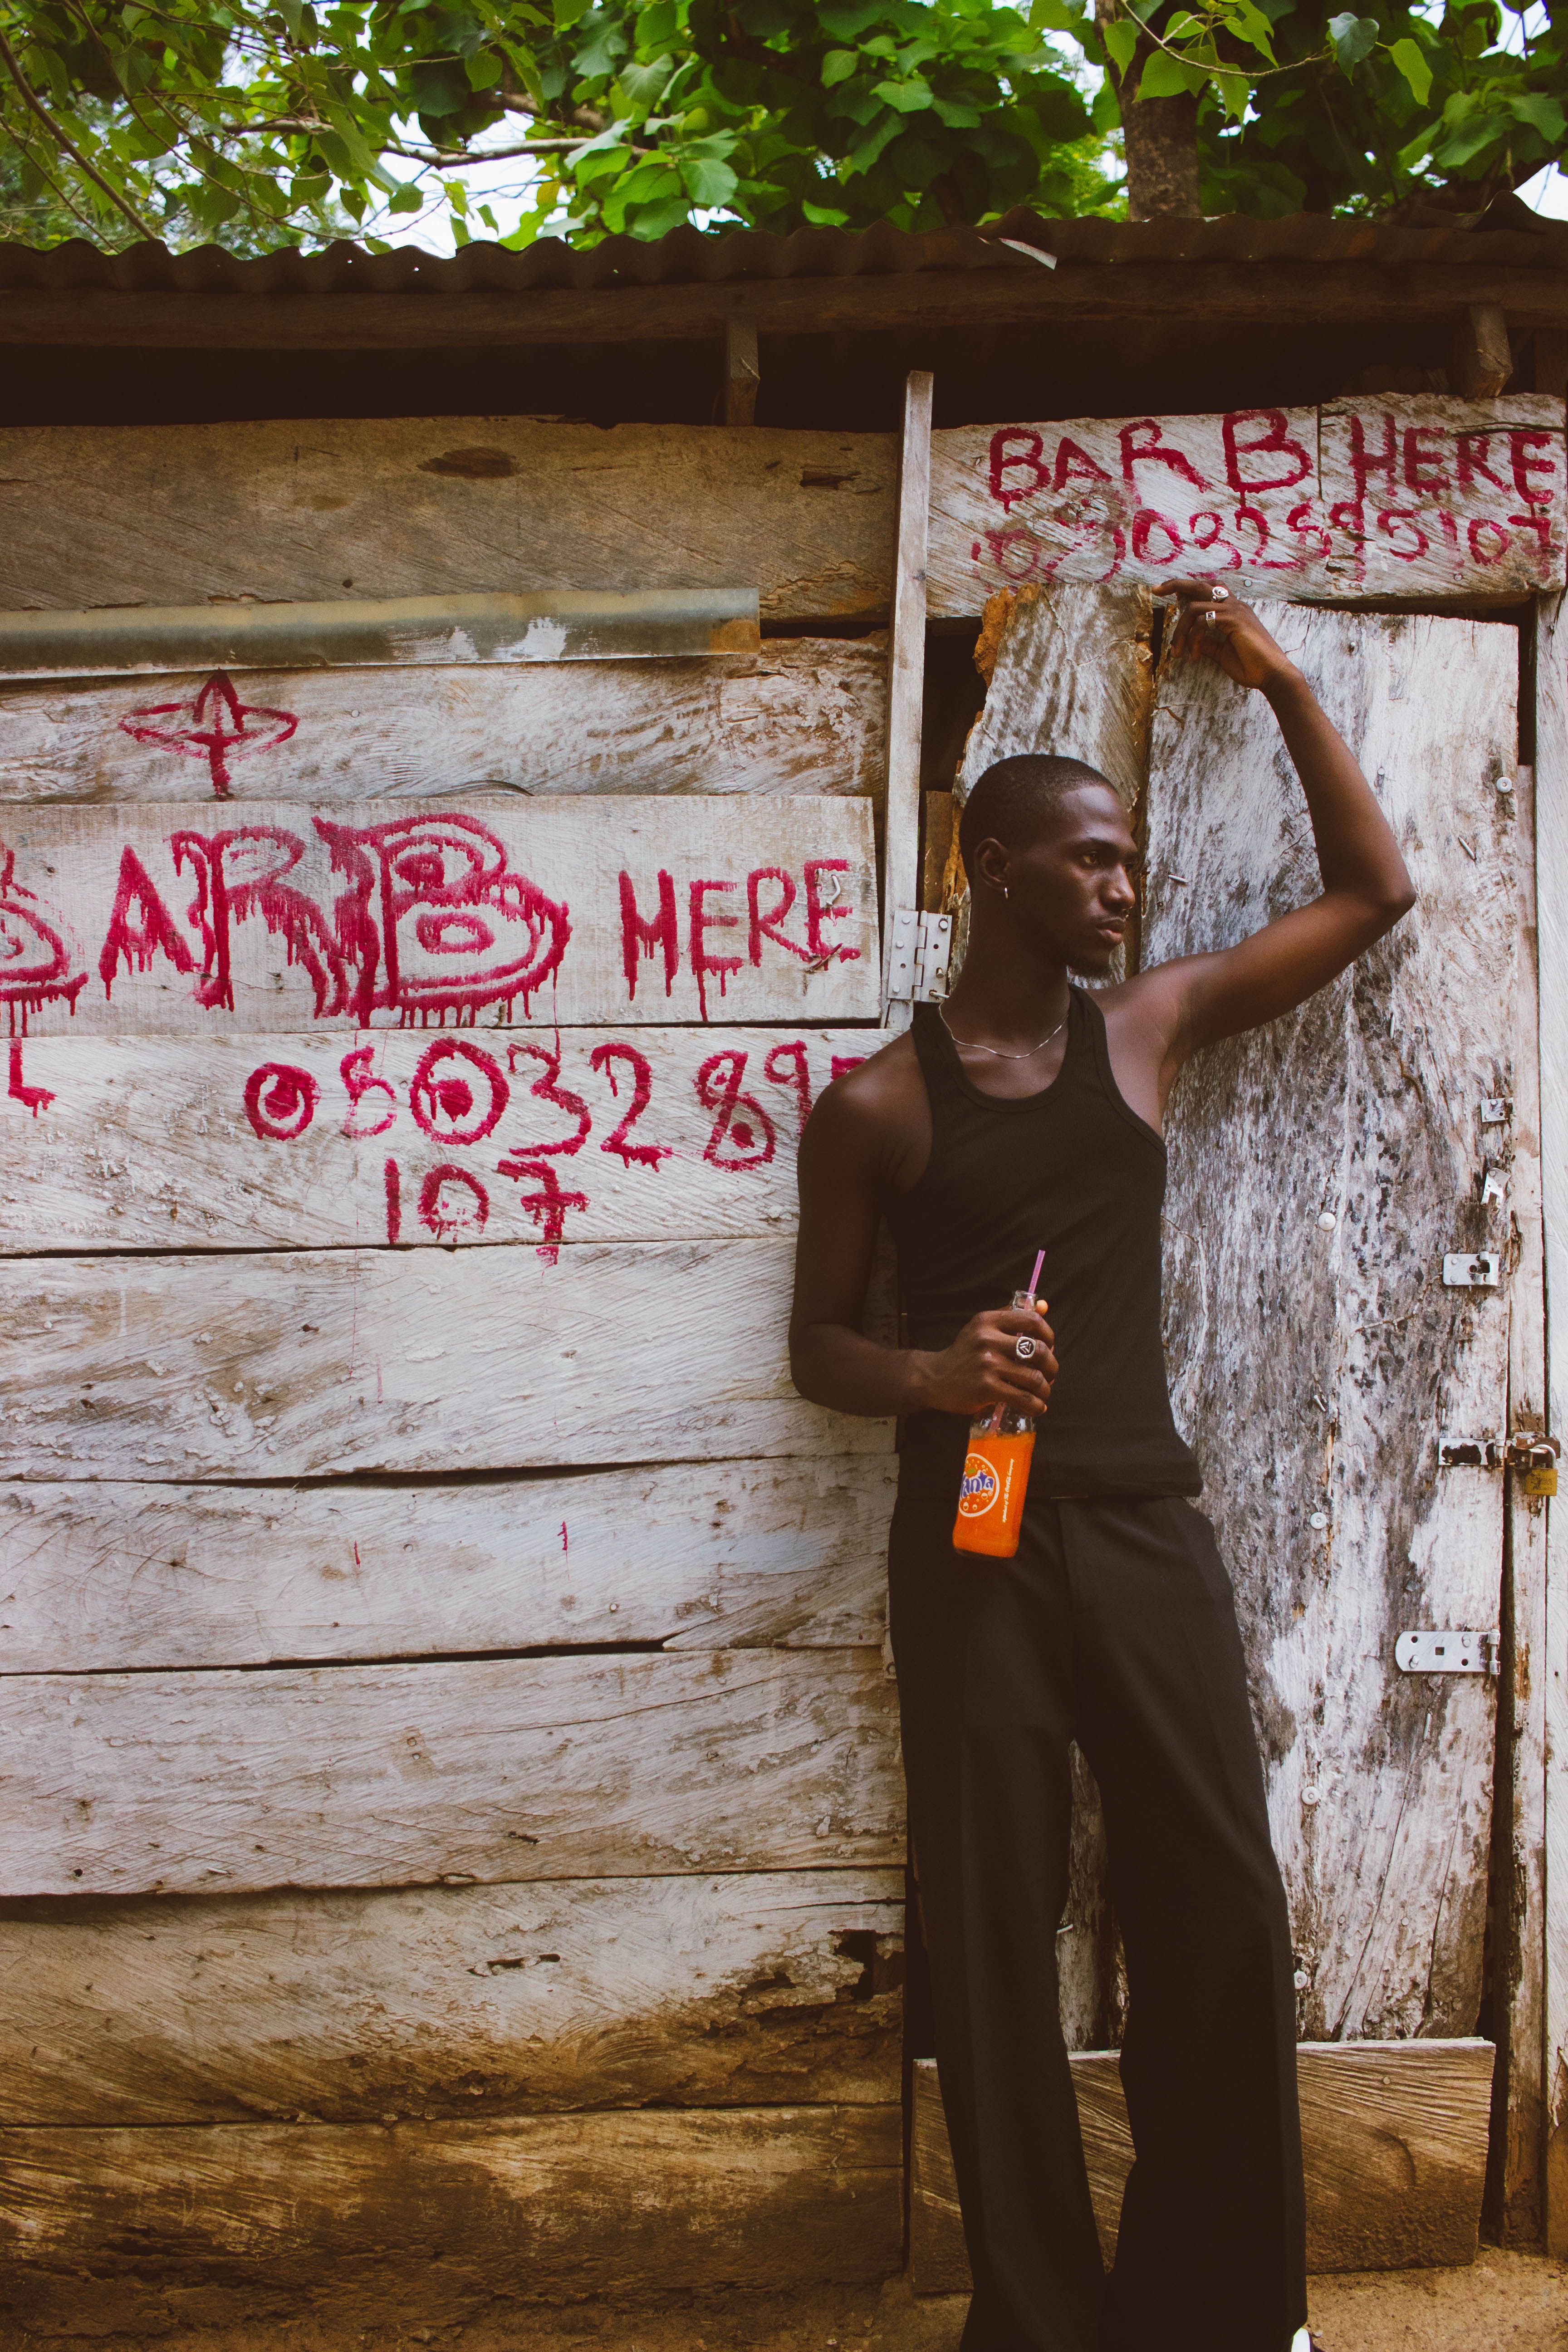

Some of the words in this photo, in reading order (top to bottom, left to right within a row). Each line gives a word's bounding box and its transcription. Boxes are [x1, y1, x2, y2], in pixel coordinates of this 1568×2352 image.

[989, 408, 1313, 513] BARB
[1349, 412, 1555, 505] HERE
[619, 859, 861, 1021] HERE
[384, 1158, 590, 1265] 107
